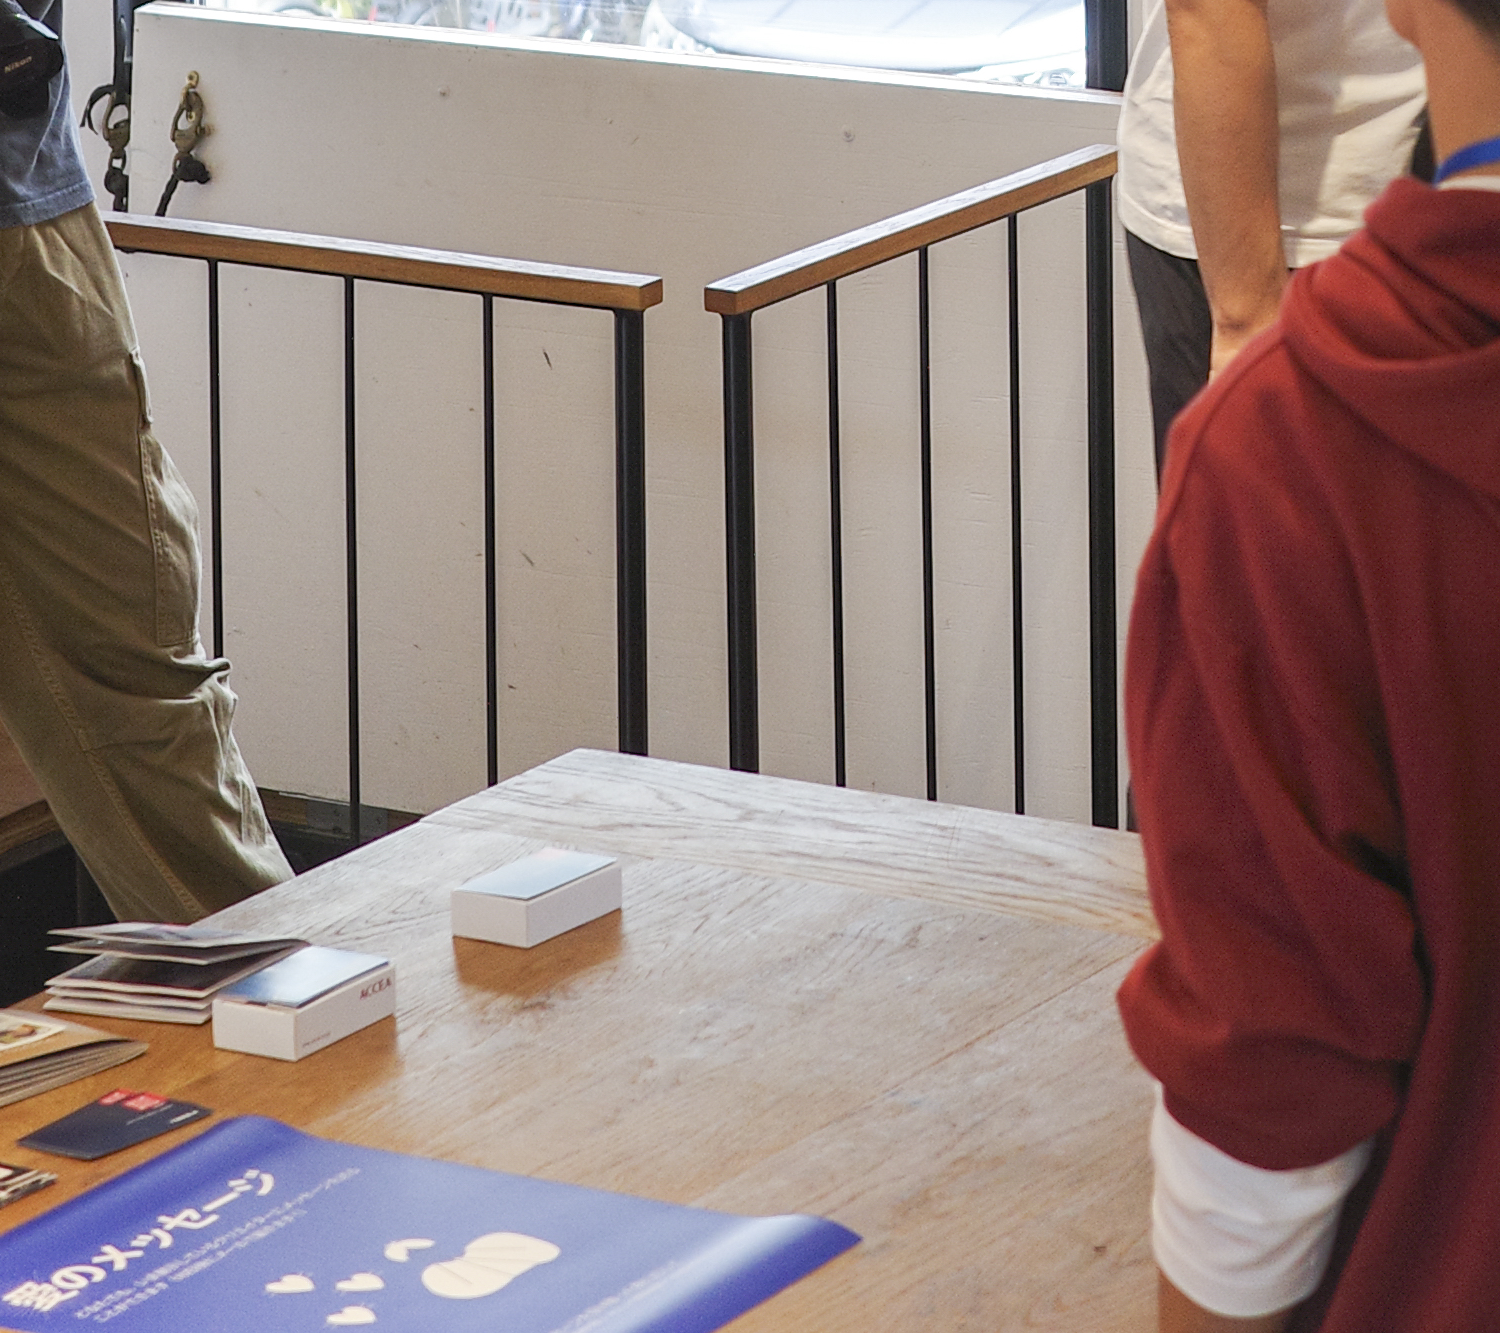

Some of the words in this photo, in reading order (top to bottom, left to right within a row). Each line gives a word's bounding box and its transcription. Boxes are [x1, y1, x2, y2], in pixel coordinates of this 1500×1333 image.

[1, 1169, 275, 1312] 愛のメッセージ
